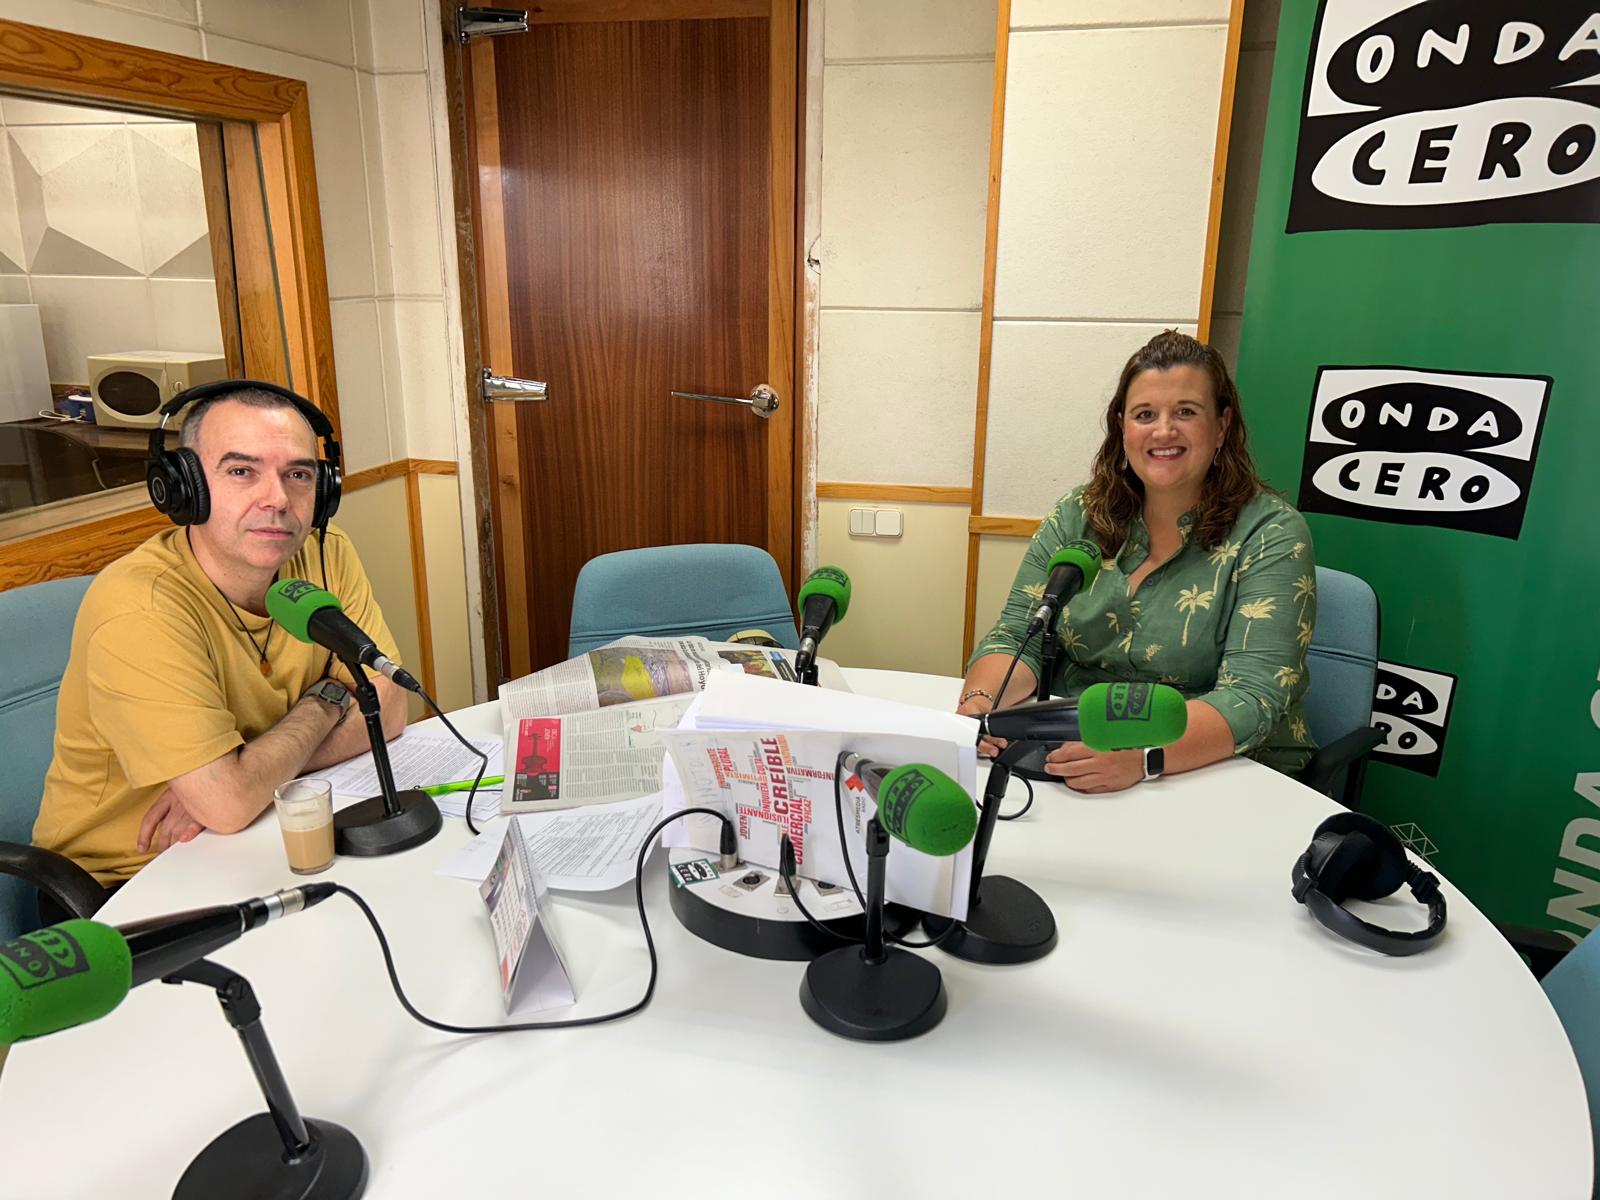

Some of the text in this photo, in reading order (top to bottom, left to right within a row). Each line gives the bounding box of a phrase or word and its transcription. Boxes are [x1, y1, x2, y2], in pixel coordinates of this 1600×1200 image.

[1356, 12, 1600, 83] ONDA
[1352, 121, 1597, 186] CERO
[1340, 399, 1499, 438] ONDA
[1338, 458, 1490, 504] CERO
[1113, 685, 1127, 711] ERO
[1375, 683, 1423, 710] DA
[1373, 721, 1418, 750] RO
[717, 747, 733, 772] PLURAL
[786, 767, 835, 780] INFORMATIVA
[760, 738, 789, 815] CREÍBLE
[761, 783, 771, 813] INQUIETA
[739, 806, 789, 824] ILUSIONANTE
[739, 815, 748, 840] JOVEN
[789, 798, 803, 865] COMERCIAL
